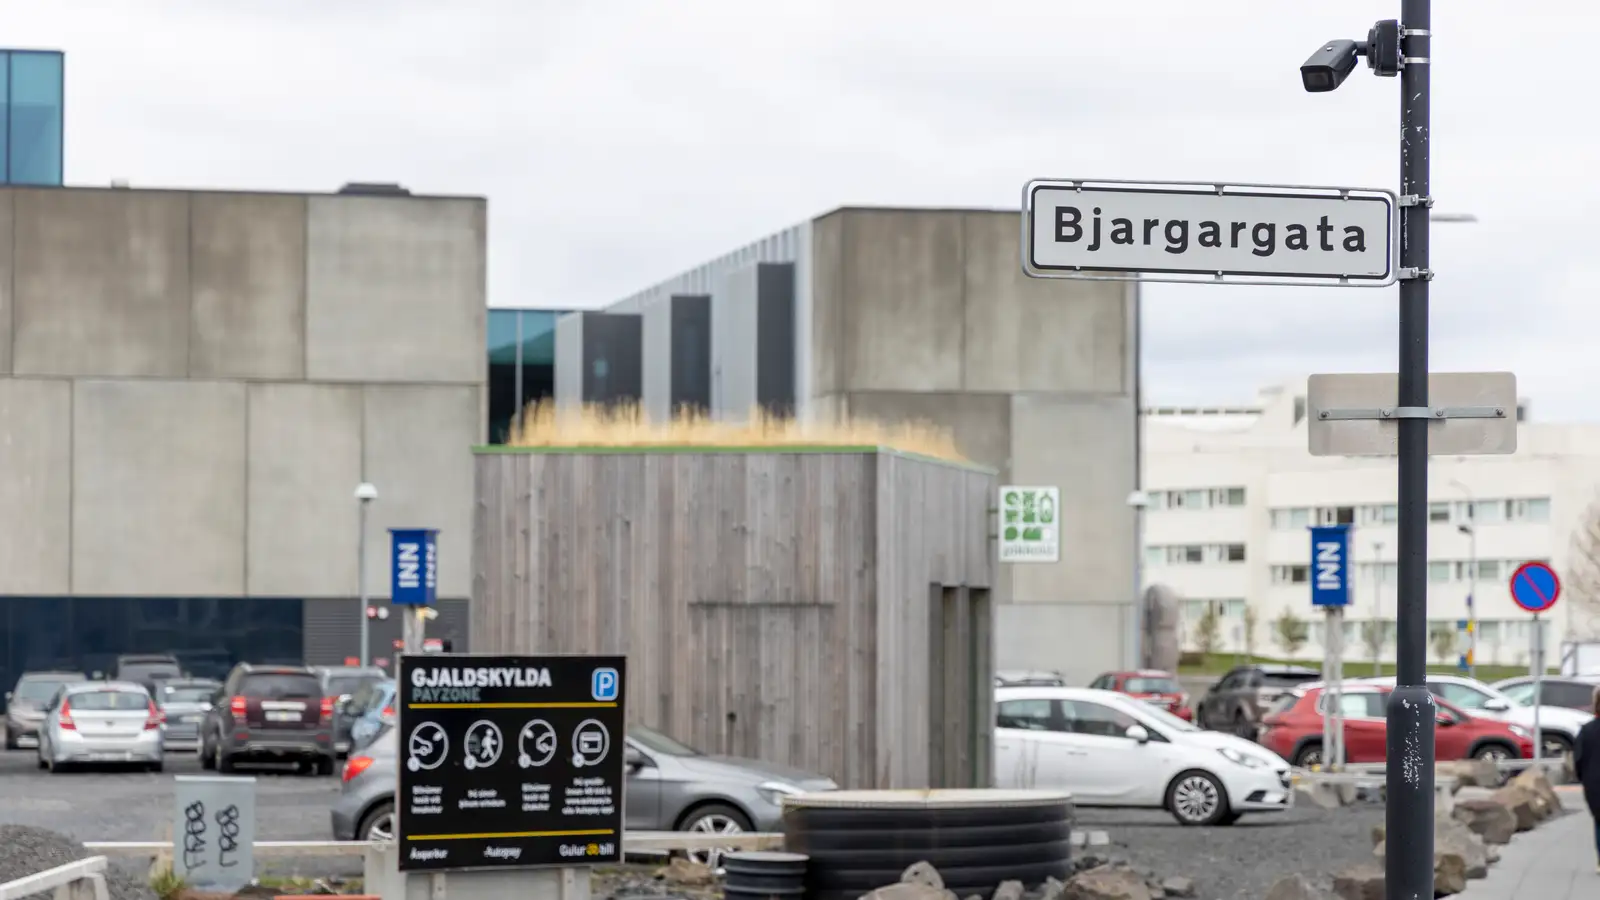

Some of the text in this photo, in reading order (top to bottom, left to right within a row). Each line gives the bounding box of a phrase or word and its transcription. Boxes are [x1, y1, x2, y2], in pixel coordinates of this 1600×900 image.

[1054, 205, 1367, 257] Bjargargata
[397, 542, 420, 588] INN
[1316, 542, 1341, 590] INN
[411, 667, 552, 687] GJALDSKYLDA
[412, 687, 481, 702] PAYZONE
